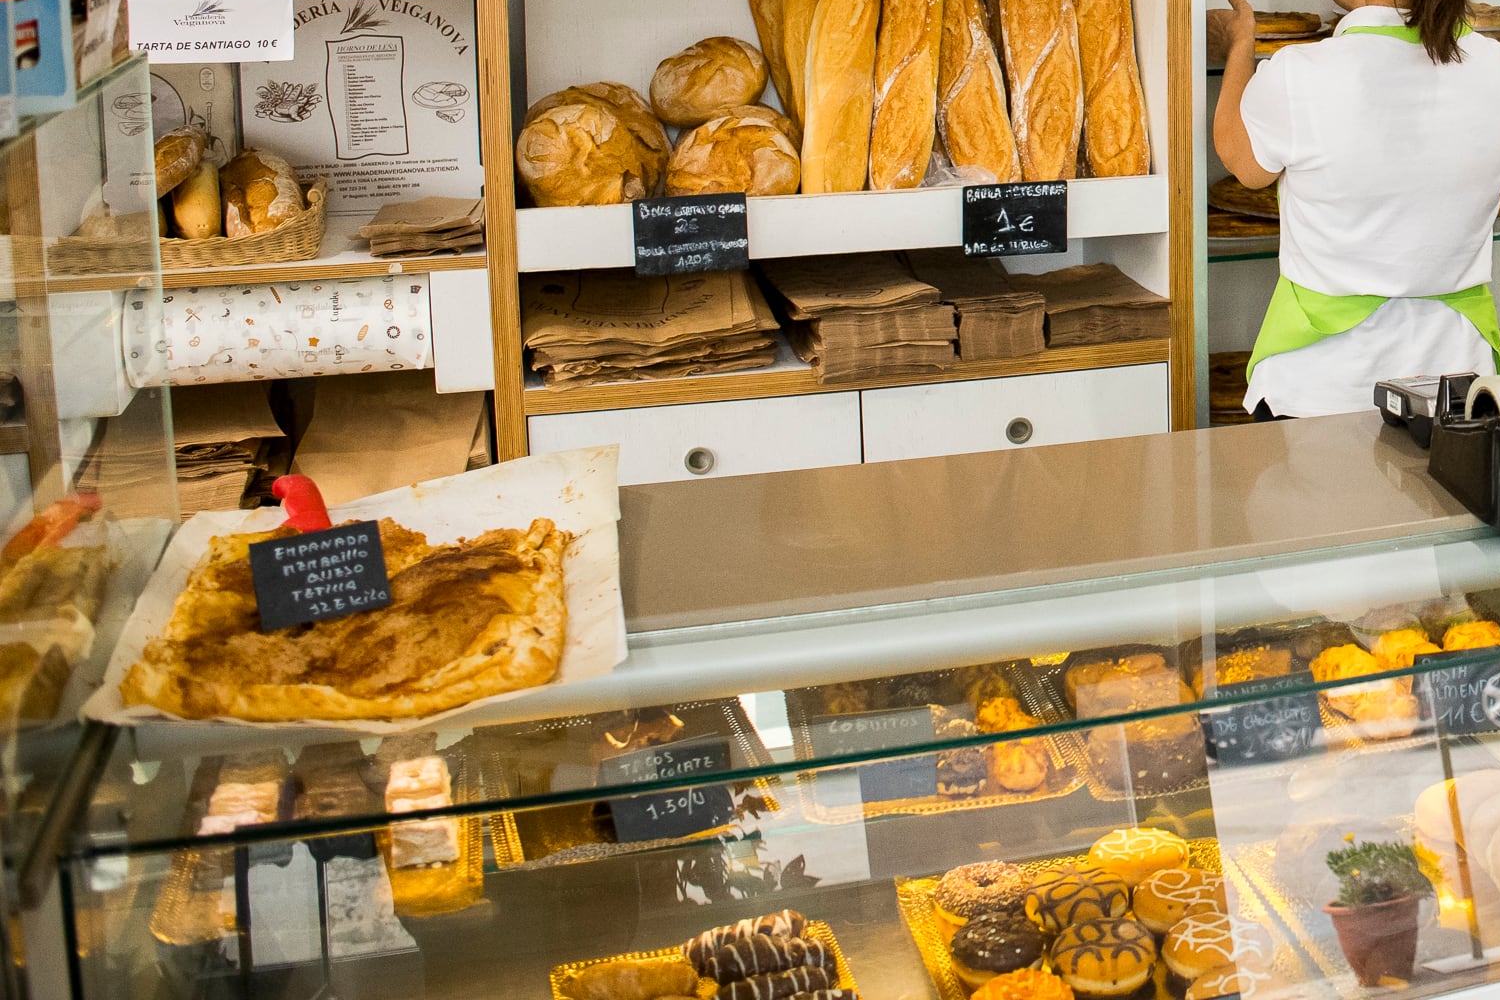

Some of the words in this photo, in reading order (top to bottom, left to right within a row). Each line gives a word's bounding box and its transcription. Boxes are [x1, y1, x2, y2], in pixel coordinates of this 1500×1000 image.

[136, 42, 173, 51] TARTA
[177, 41, 191, 51] DE
[194, 39, 251, 52] SANTIAGO
[257, 40, 269, 48] 10
[271, 39, 278, 47] €
[274, 534, 368, 560] EMPANADA
